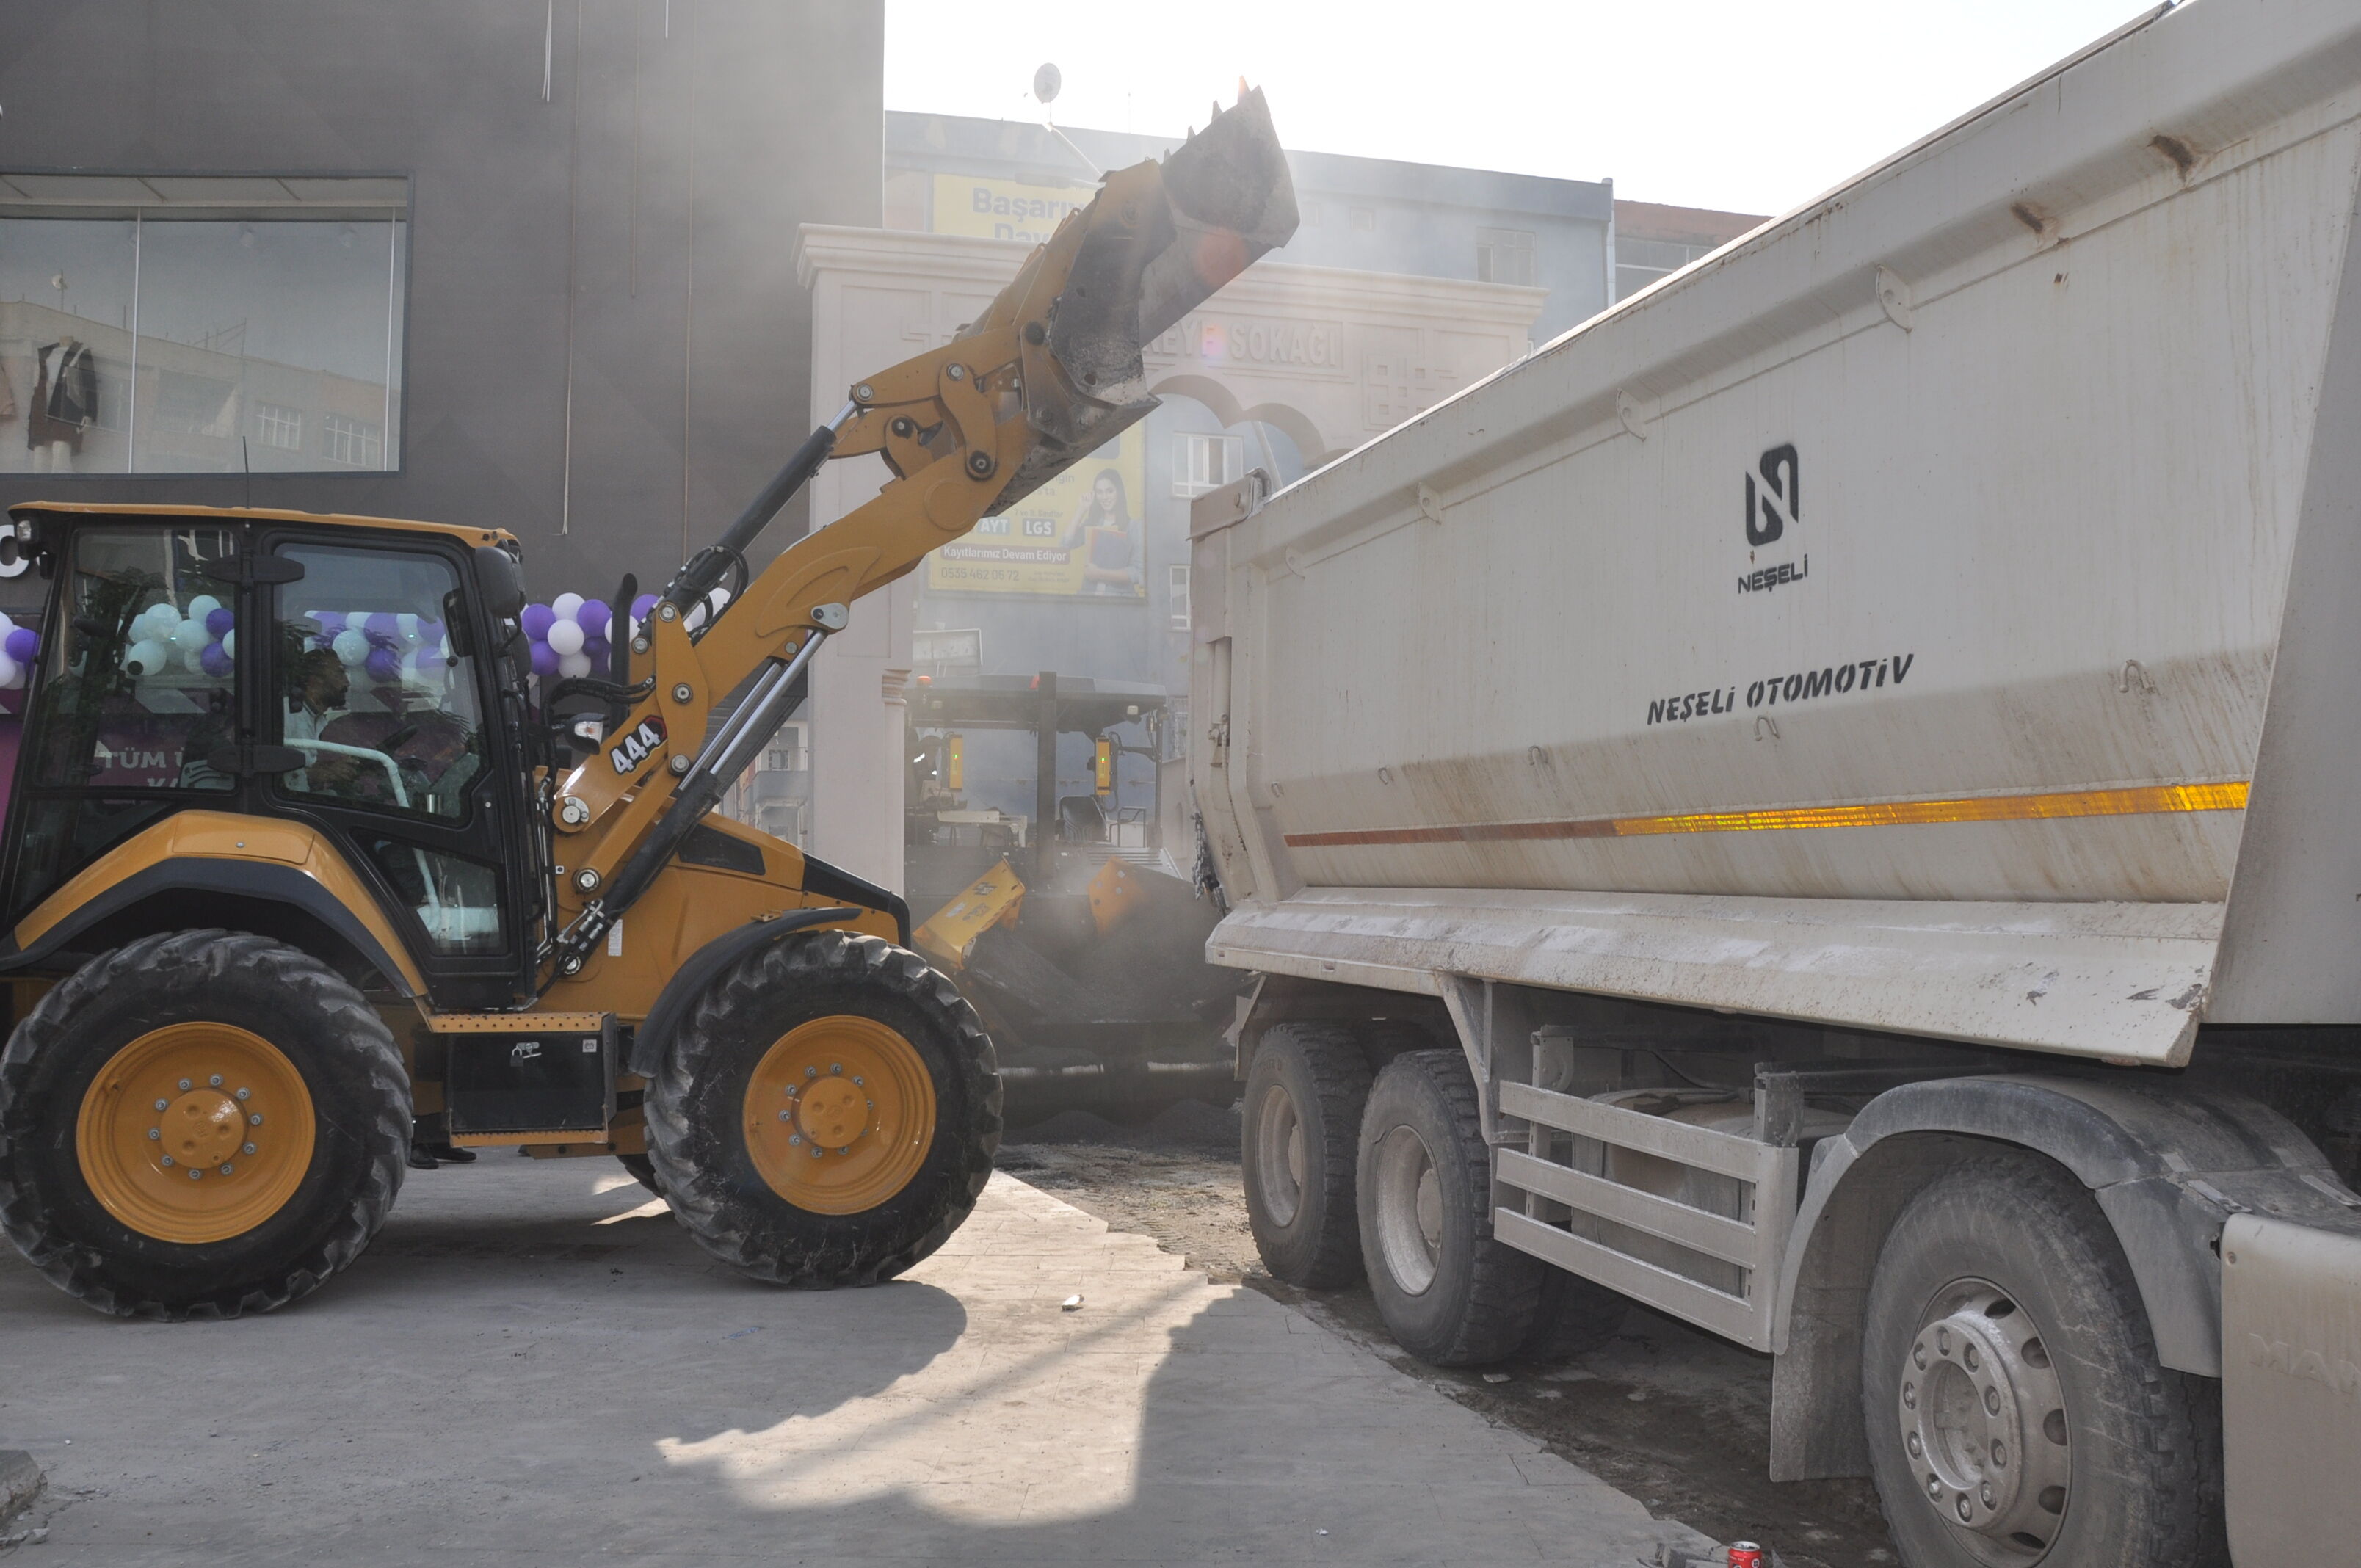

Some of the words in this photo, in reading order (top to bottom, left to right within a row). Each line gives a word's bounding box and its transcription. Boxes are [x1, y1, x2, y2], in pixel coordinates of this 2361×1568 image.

[1229, 322, 1336, 367] SOKAĞI
[980, 518, 1008, 534] AYT
[1026, 520, 1052, 536] LGS
[944, 545, 1000, 560] Kayıtlarımız
[1002, 549, 1035, 560] Devam
[1037, 550, 1067, 563] Ediyor
[1008, 570, 1020, 581] 72
[611, 722, 661, 774] 444
[99, 747, 167, 769] TÜM
